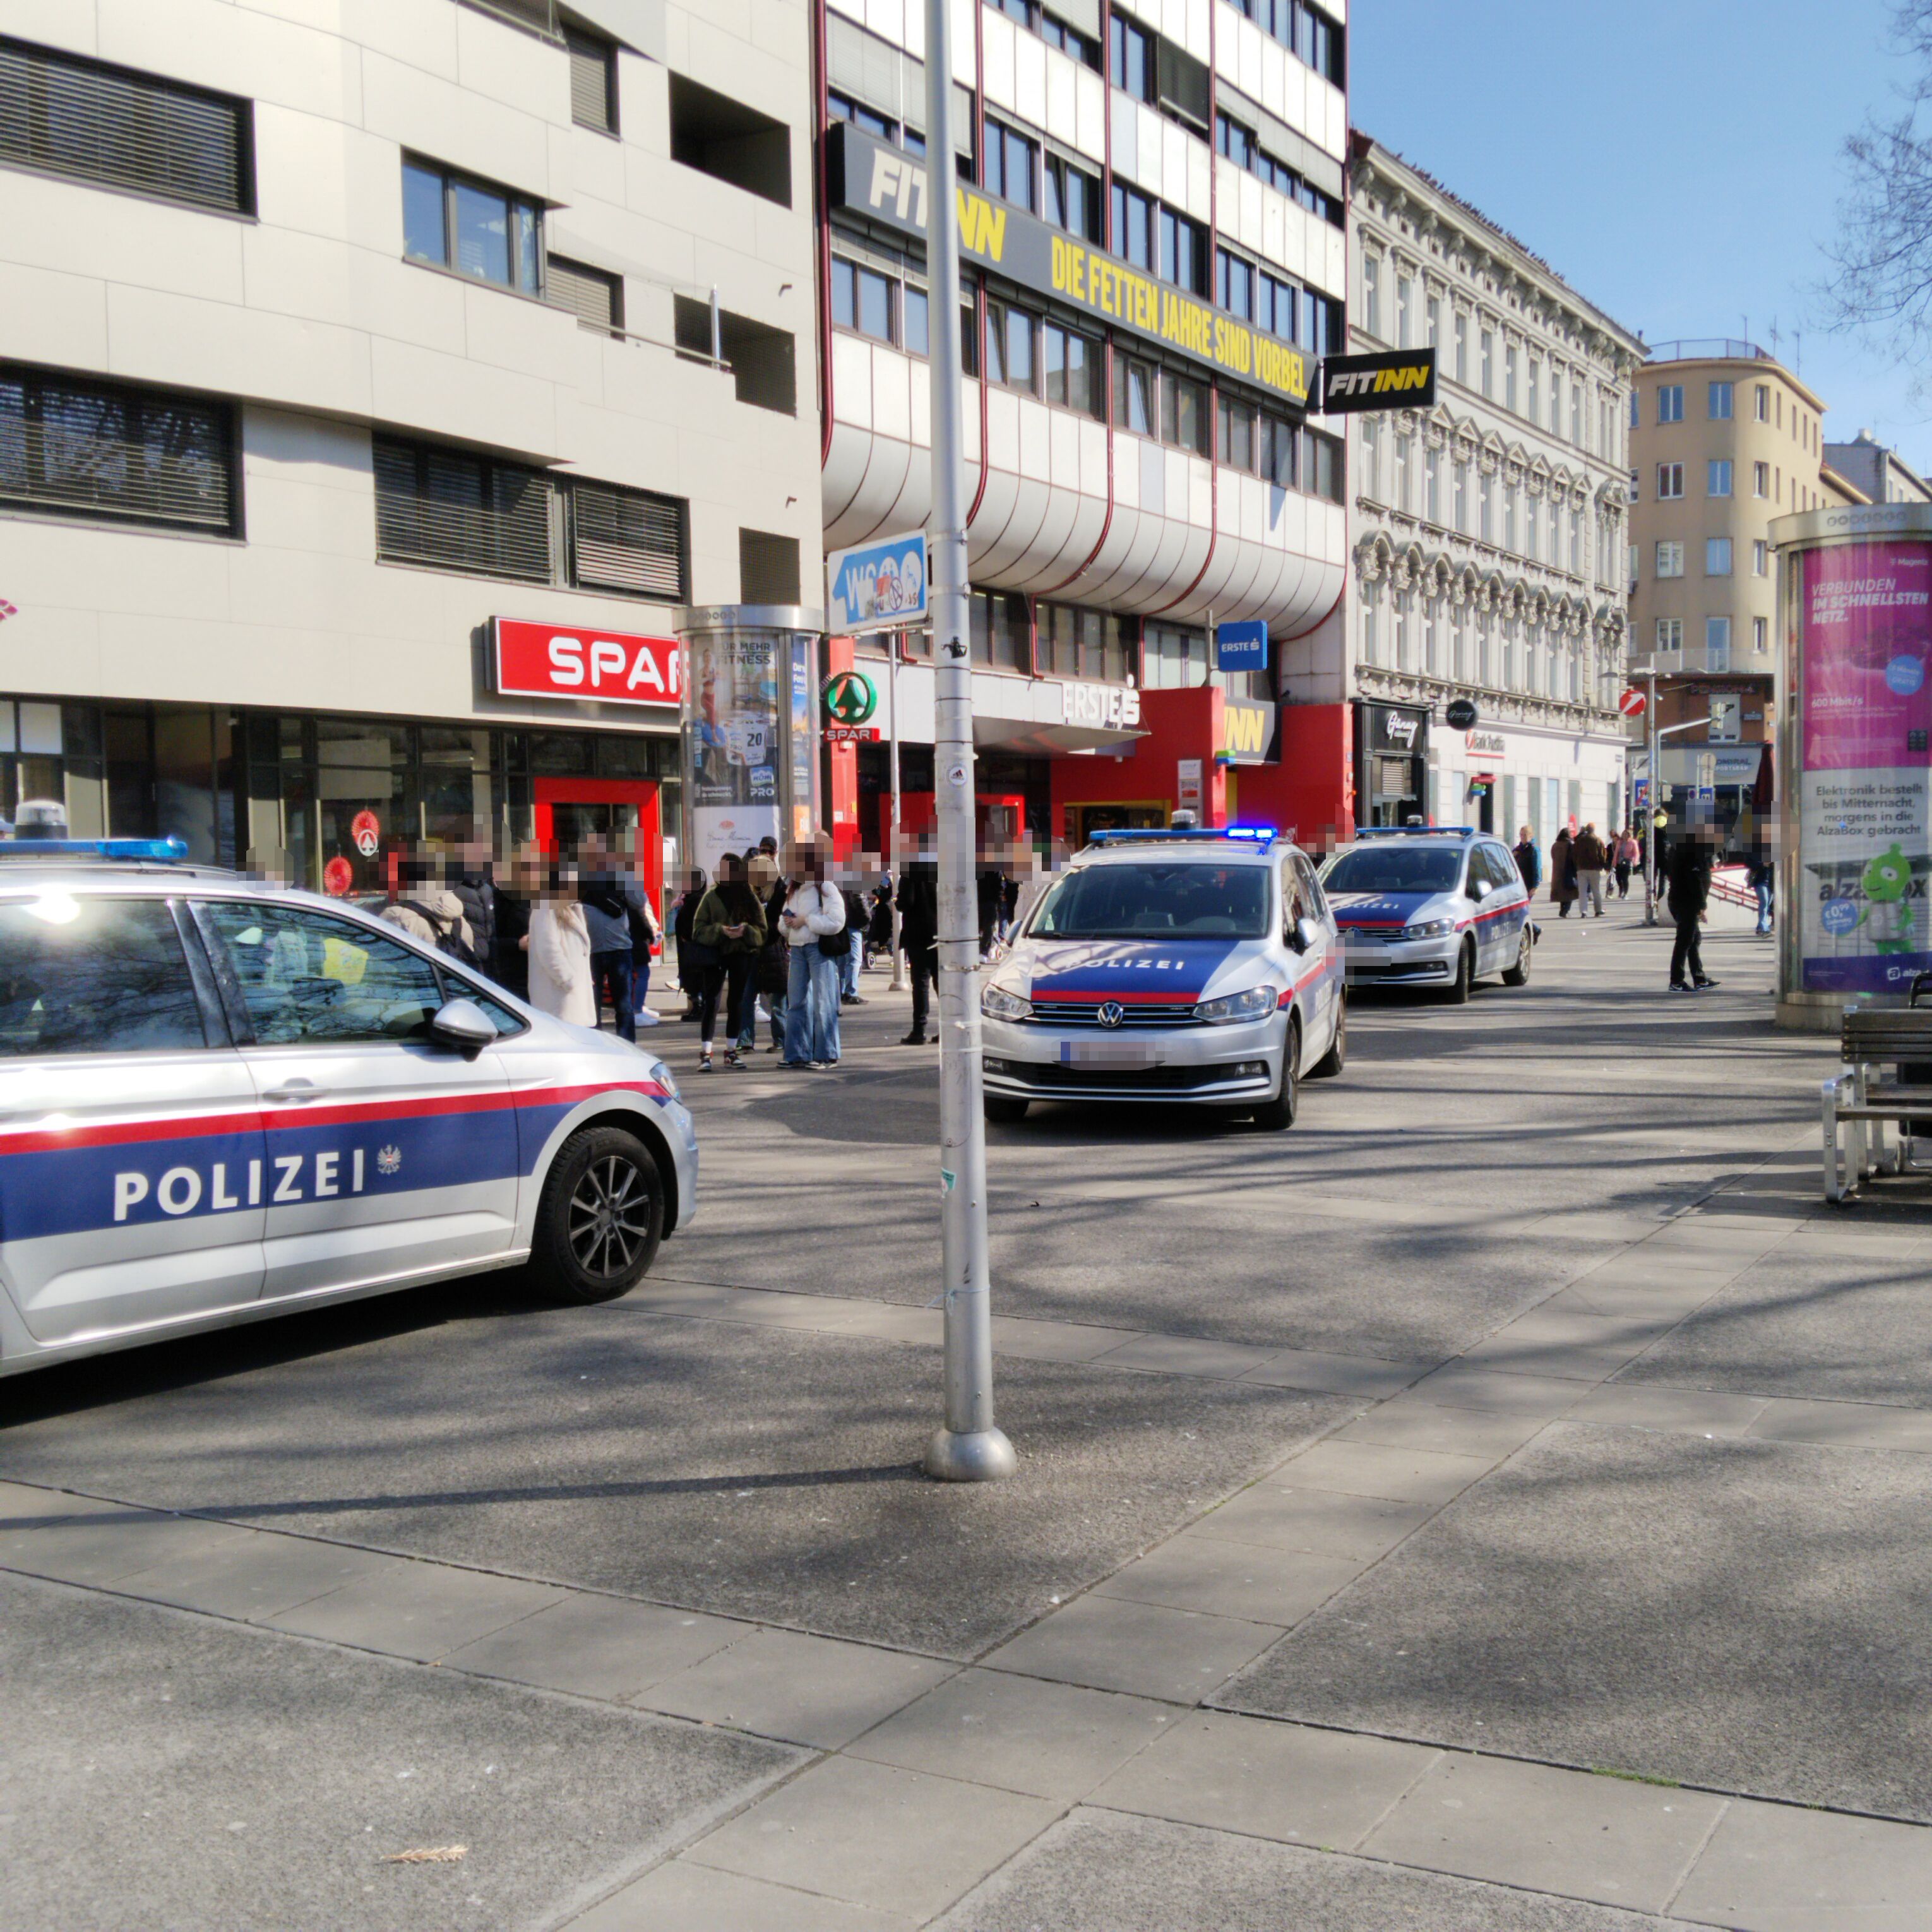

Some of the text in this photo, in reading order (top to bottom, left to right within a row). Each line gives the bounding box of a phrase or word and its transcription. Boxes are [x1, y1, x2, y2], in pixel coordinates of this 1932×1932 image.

[870, 147, 1006, 263] FITNN
[1052, 236, 1085, 301] DIE
[1089, 254, 1159, 334] FETTEN
[1162, 290, 1212, 358] JAHRE
[1215, 317, 1251, 374] SIND
[1328, 366, 1429, 397] FITINN
[1812, 578, 1896, 596] VERBUNDEN
[1812, 592, 1929, 611] IM SCHNELLSTEN
[1812, 609, 1849, 624] NETZ.
[740, 642, 770, 651] MEHR
[1221, 641, 1249, 652] ERSTE
[1063, 683, 1121, 725] ERSTE
[1812, 698, 1828, 708] 600
[747, 732, 762, 747] 20
[826, 729, 870, 741] SPAR
[750, 788, 775, 796] PRO
[1816, 784, 1923, 796] Elektronik bestellt
[1822, 797, 1916, 809] bis Mitternacht,
[1824, 811, 1914, 825] morgens in die
[1817, 824, 1921, 837] AlzaBox gebracht
[114, 1149, 364, 1221] POLIZEI
